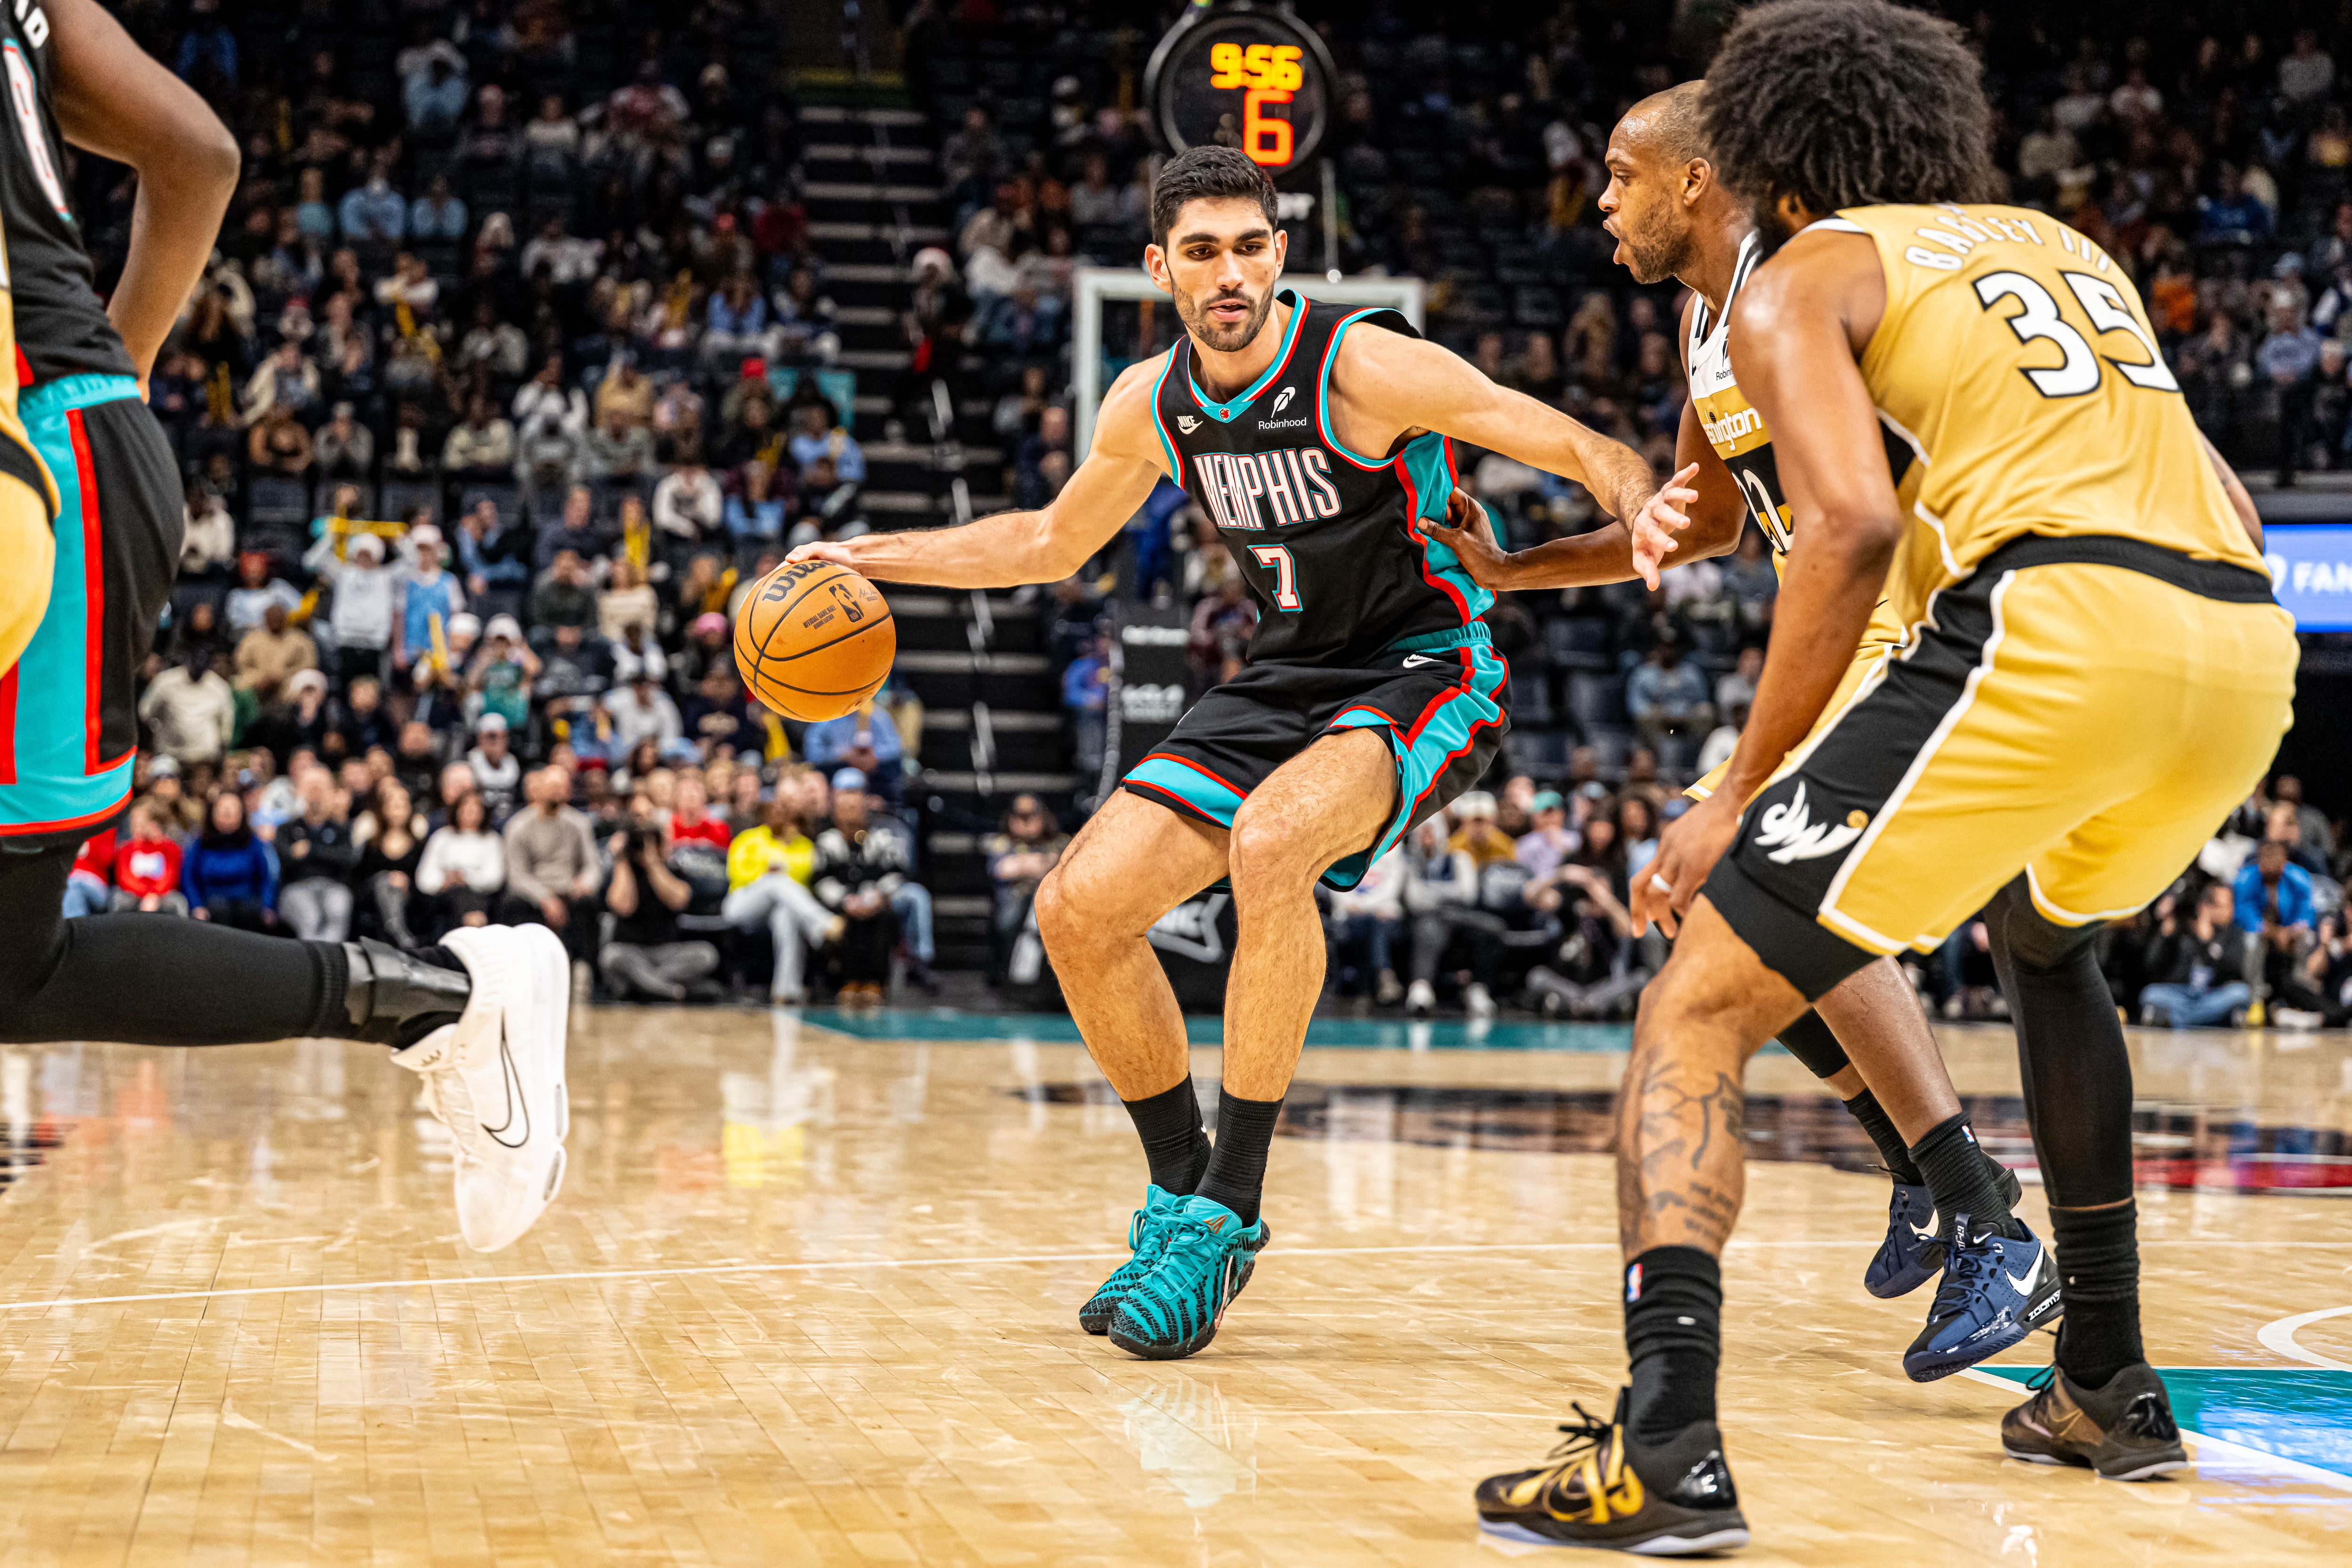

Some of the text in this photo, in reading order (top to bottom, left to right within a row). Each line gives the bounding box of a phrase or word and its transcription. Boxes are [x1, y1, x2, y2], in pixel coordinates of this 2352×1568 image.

[1243, 88, 1294, 166] 6
[1904, 215, 2110, 273] BAGLEY III
[1971, 270, 2181, 399] 35
[1177, 415, 1195, 428] NIKE
[1258, 417, 1307, 430] Robinhood
[1192, 447, 1342, 531] MEMPHIS
[1247, 543, 1303, 612] 7
